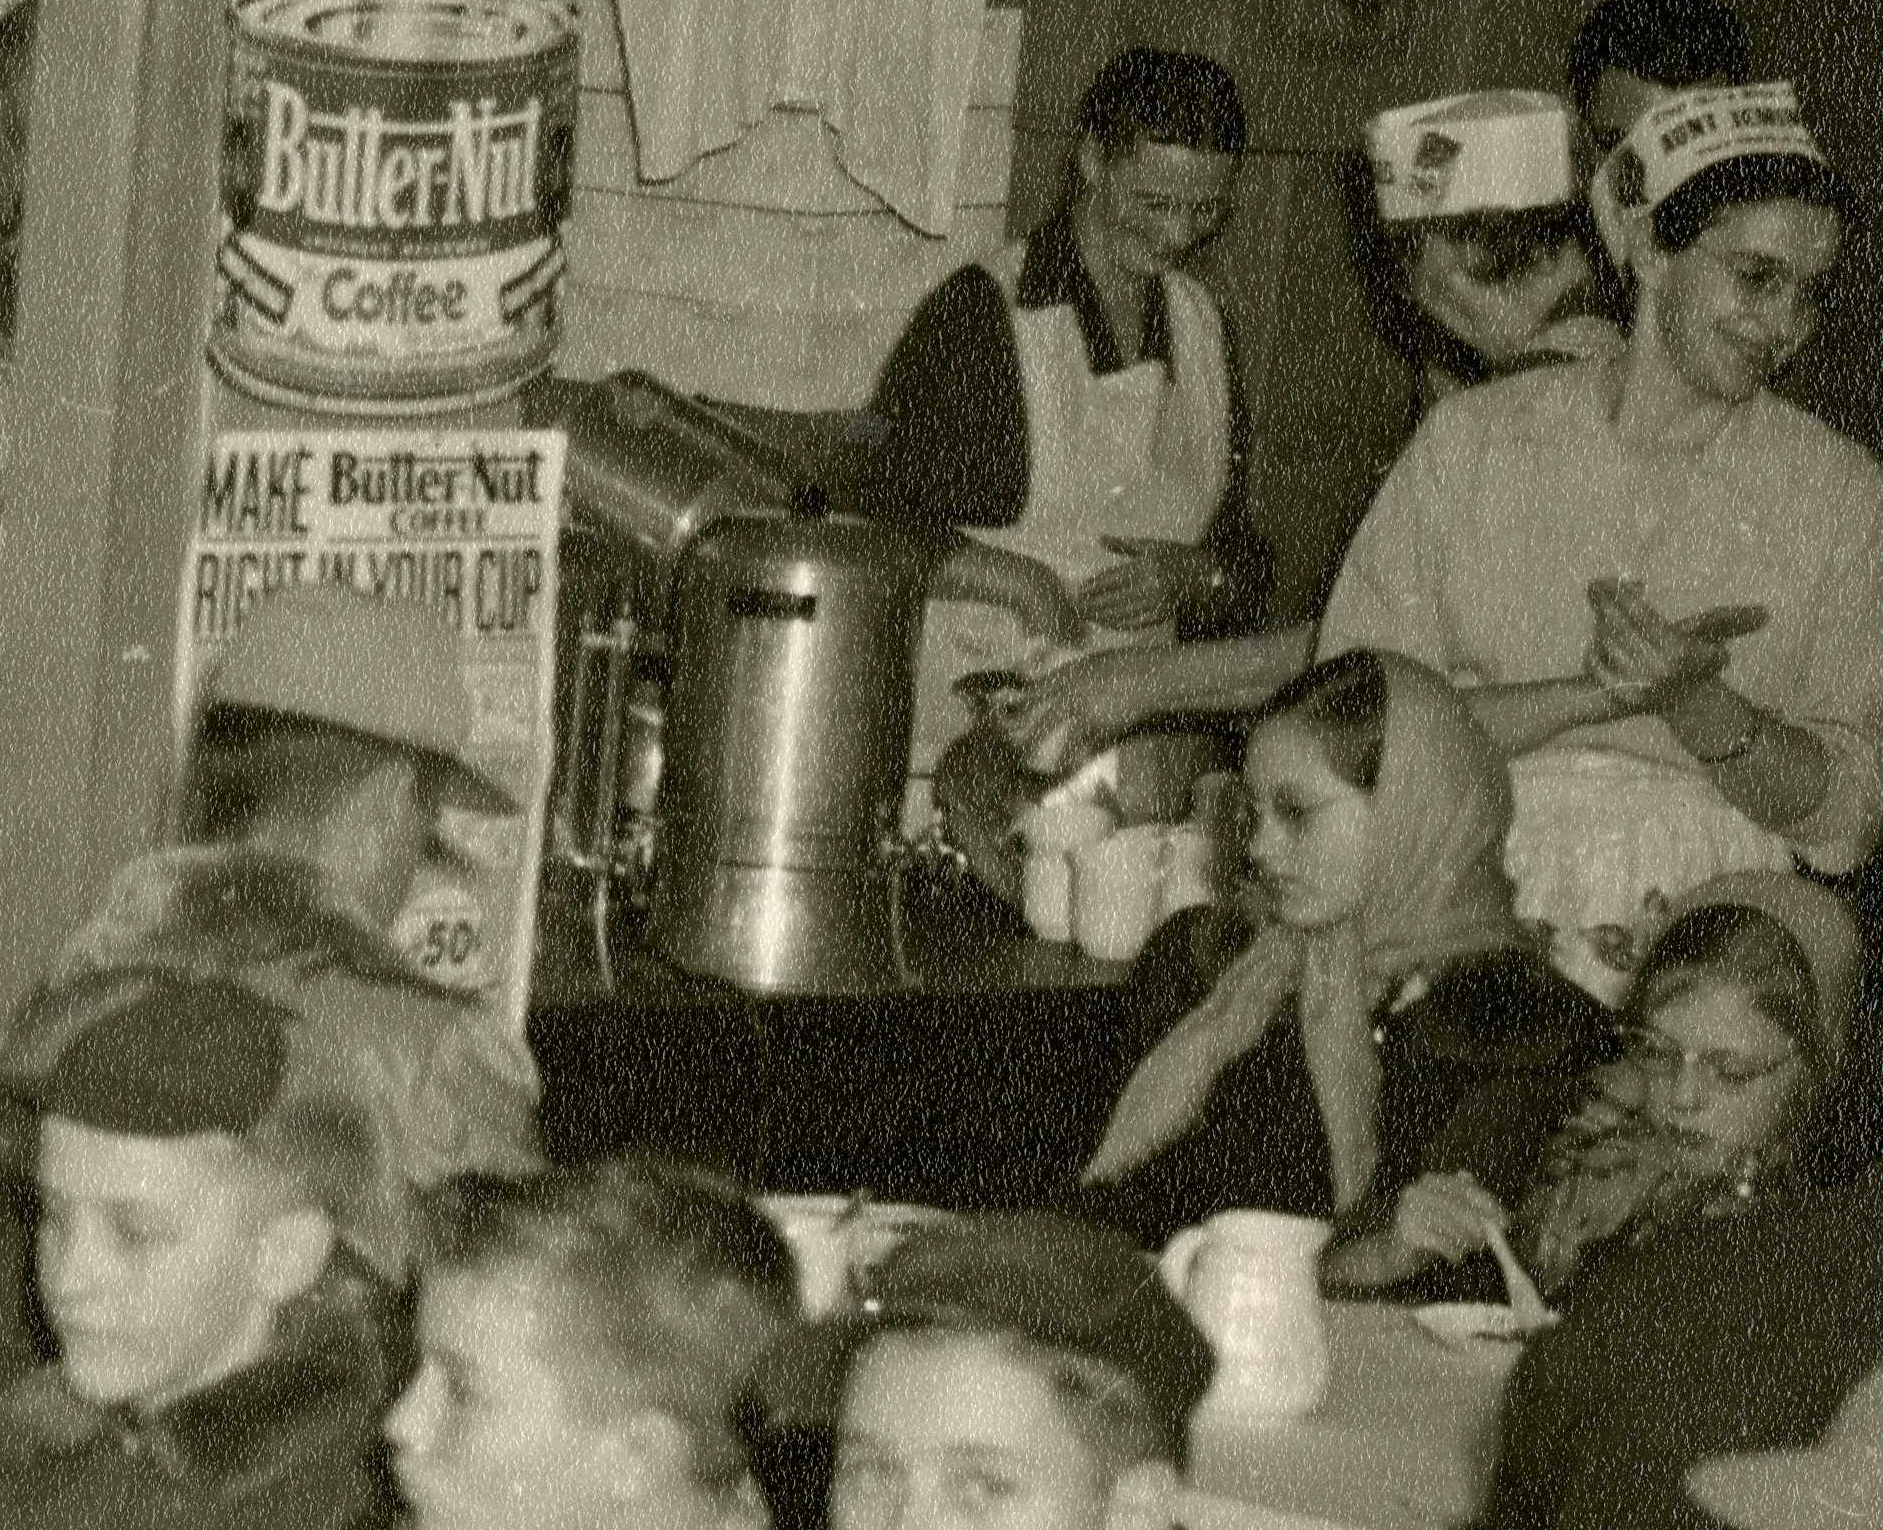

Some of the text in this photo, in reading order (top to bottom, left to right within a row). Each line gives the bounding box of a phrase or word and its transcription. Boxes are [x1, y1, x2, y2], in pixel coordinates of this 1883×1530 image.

[322, 270, 469, 326] Coffee
[200, 450, 309, 535] MAKE
[476, 548, 541, 632] CUP
